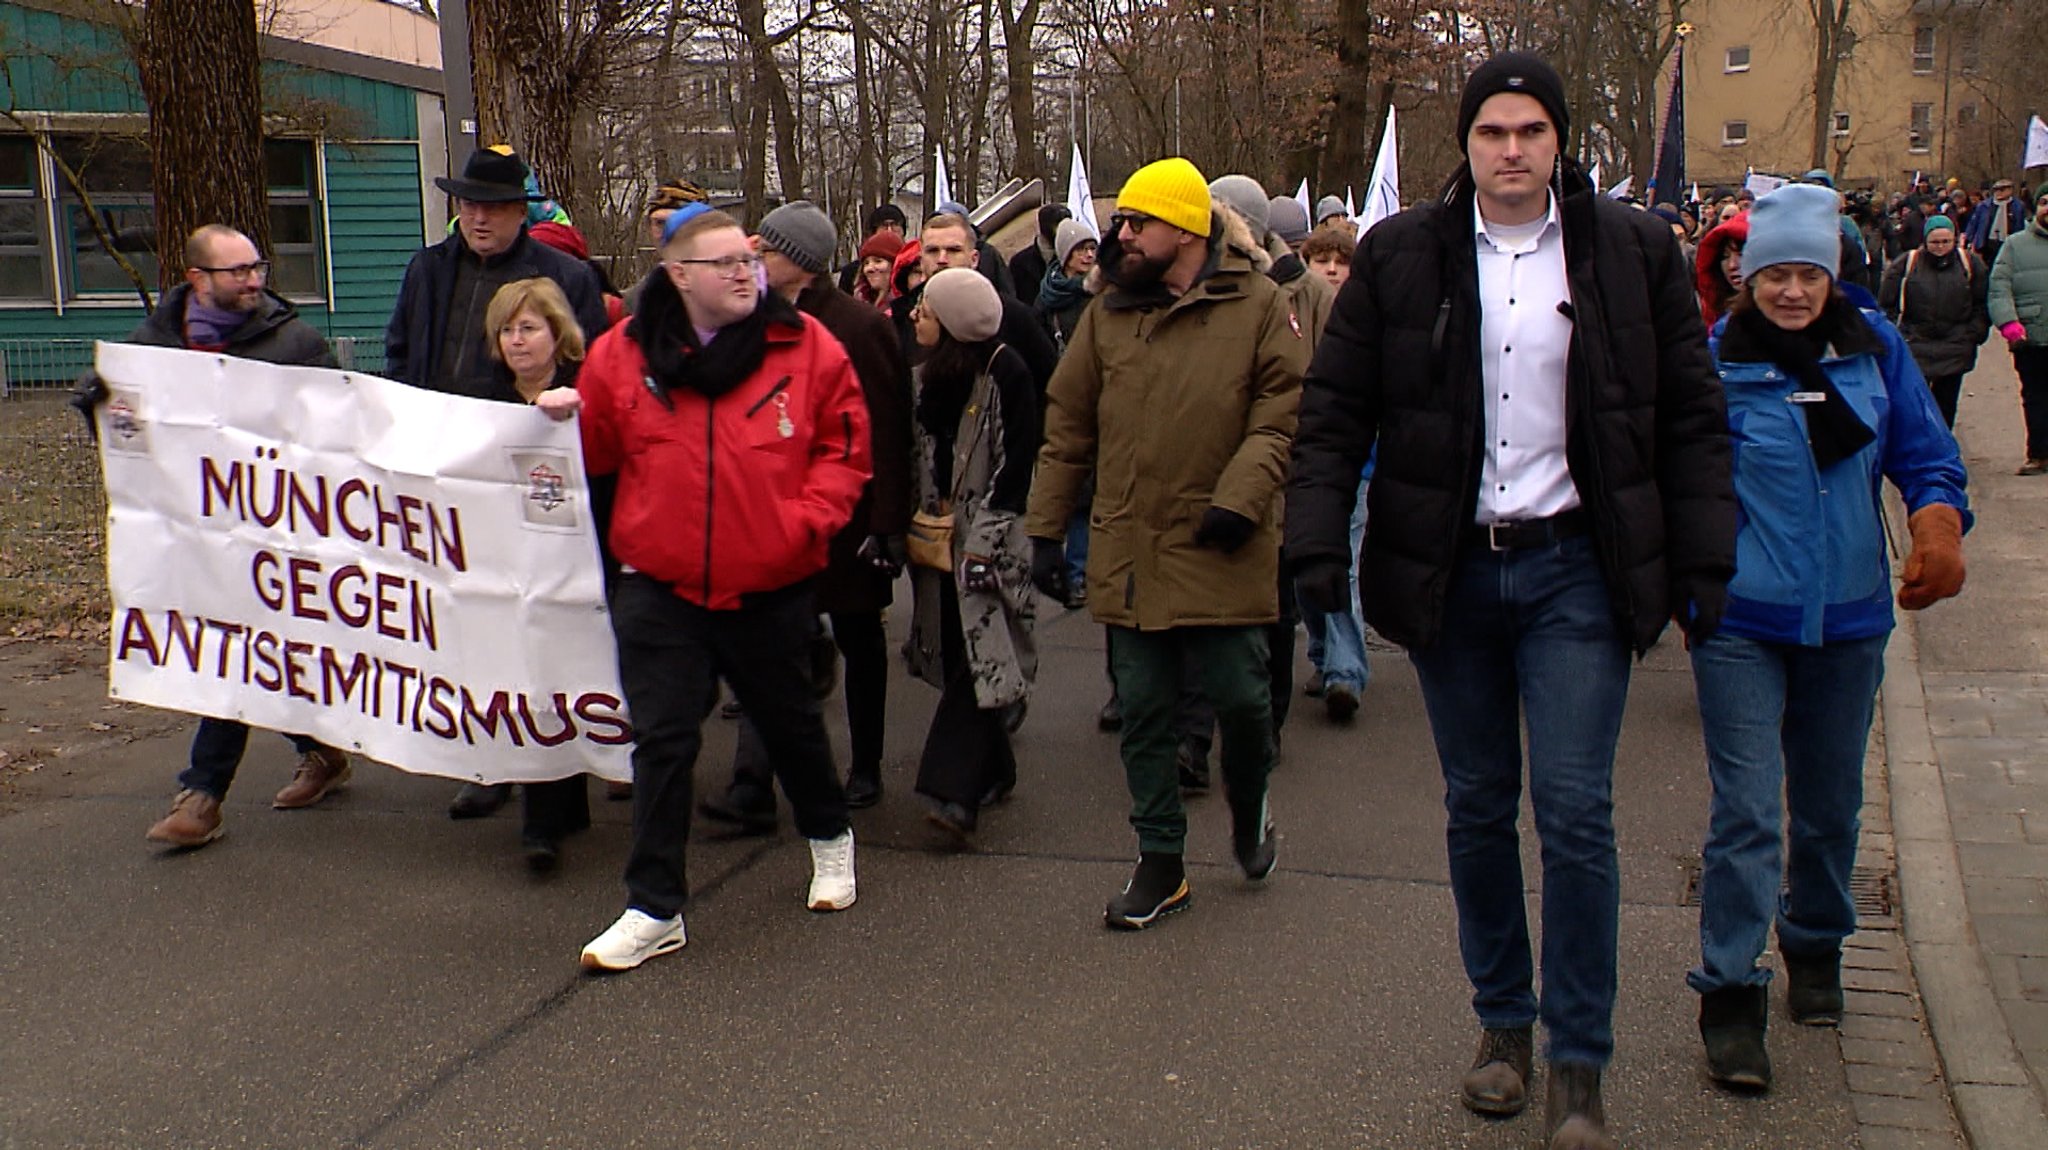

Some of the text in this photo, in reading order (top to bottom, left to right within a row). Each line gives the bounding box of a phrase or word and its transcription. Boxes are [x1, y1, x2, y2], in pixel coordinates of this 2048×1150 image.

[201, 445, 467, 572] MÜNCHEN
[252, 549, 437, 651] GEGEN
[117, 607, 633, 747] ANTISEMITISMUS
